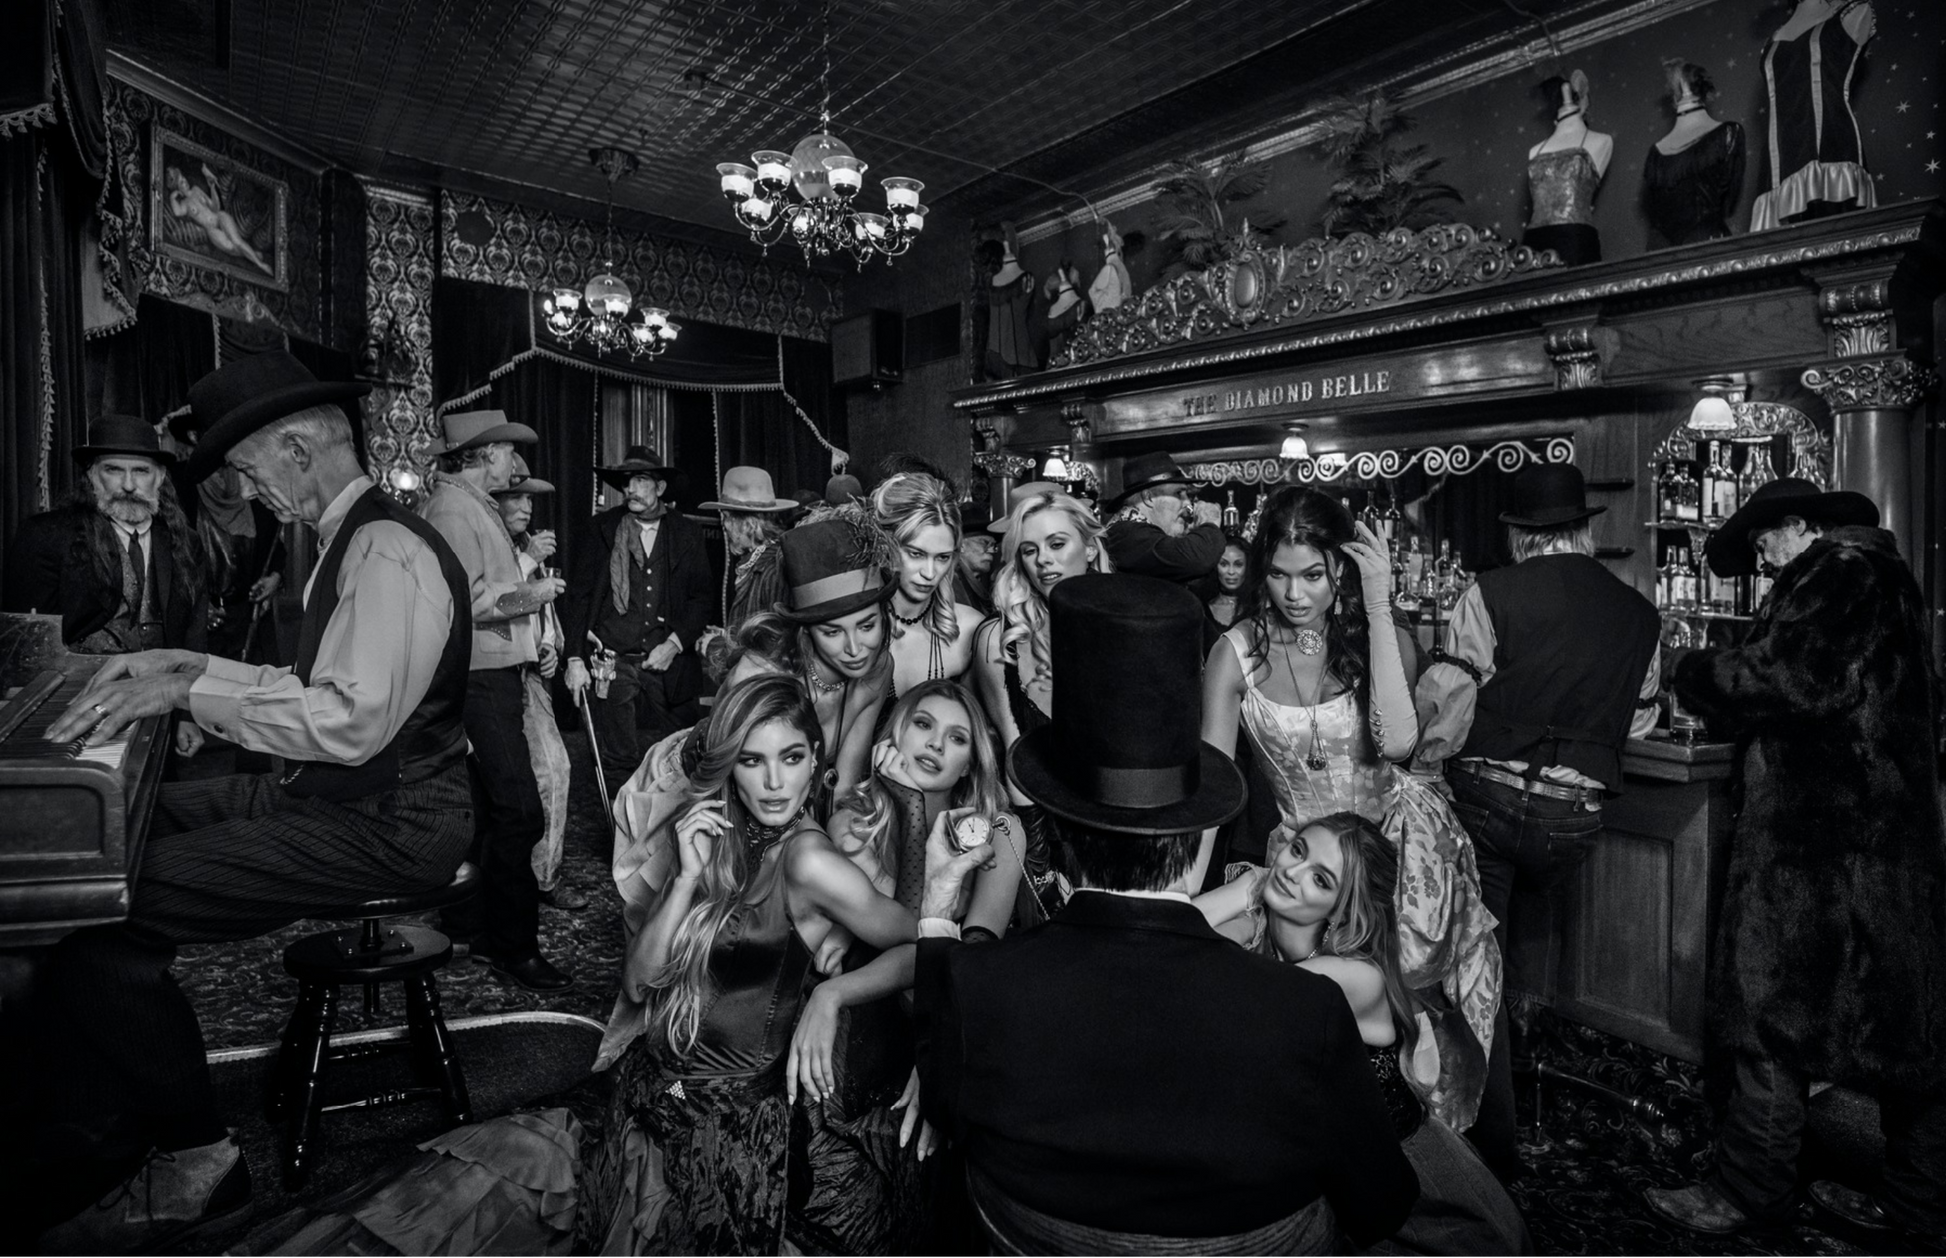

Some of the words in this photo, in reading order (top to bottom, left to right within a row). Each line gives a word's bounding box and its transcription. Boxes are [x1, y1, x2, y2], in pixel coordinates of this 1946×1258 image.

[1184, 393, 1217, 417] THE
[1224, 381, 1313, 411] DIAMOND
[1321, 371, 1390, 399] BELLE
